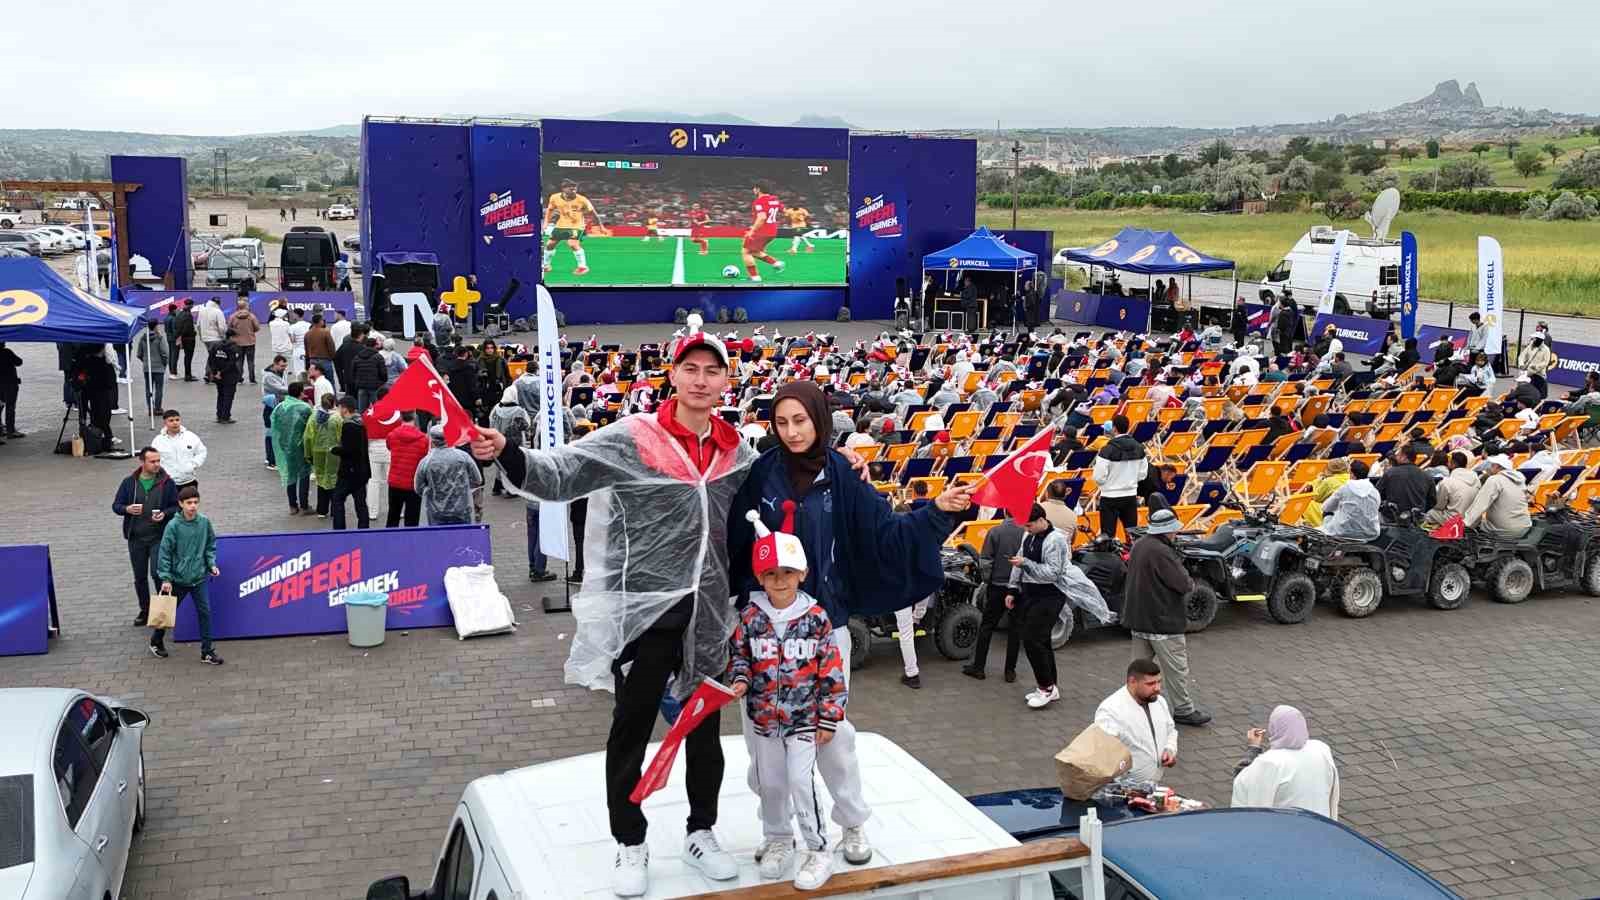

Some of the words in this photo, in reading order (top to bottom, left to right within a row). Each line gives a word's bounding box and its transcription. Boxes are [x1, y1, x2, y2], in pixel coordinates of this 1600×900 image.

[702, 130, 729, 148] TV+
[1404, 252, 1412, 301] TURKCELL
[1486, 260, 1496, 312] TURKCELL
[287, 302, 335, 311] TURKLL
[1335, 328, 1369, 341] TURKCELL
[546, 343, 556, 448] URKCELL
[239, 550, 312, 598] SONUNDA
[268, 548, 362, 609] ZAFERİ
